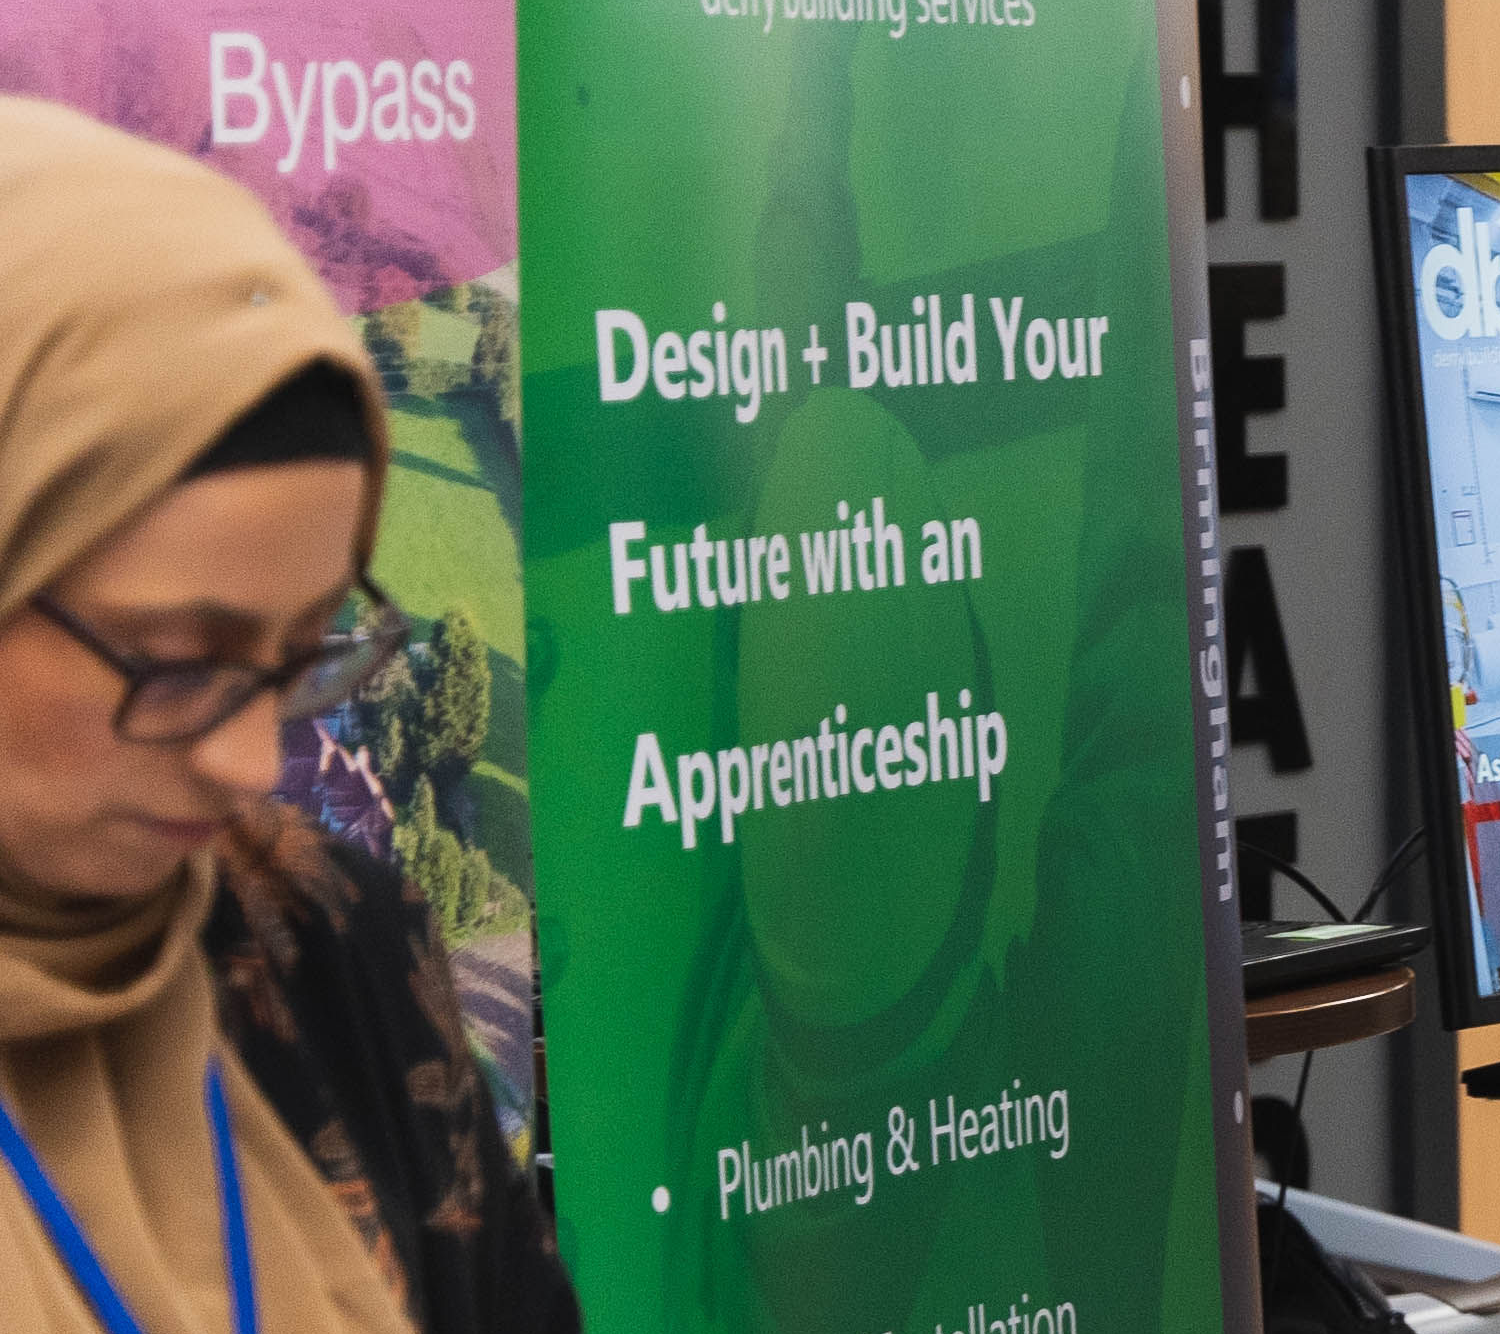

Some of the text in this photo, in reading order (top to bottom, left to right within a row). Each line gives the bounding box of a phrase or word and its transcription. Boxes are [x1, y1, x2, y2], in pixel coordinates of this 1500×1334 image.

[207, 29, 476, 175] Bypass
[594, 292, 1109, 426] Design + Build Your
[608, 498, 983, 616] Future with an
[1189, 337, 1235, 904] Birmingham
[621, 687, 1009, 851] Apprenticeship
[716, 1077, 1070, 1223] Plumbing & Heating
